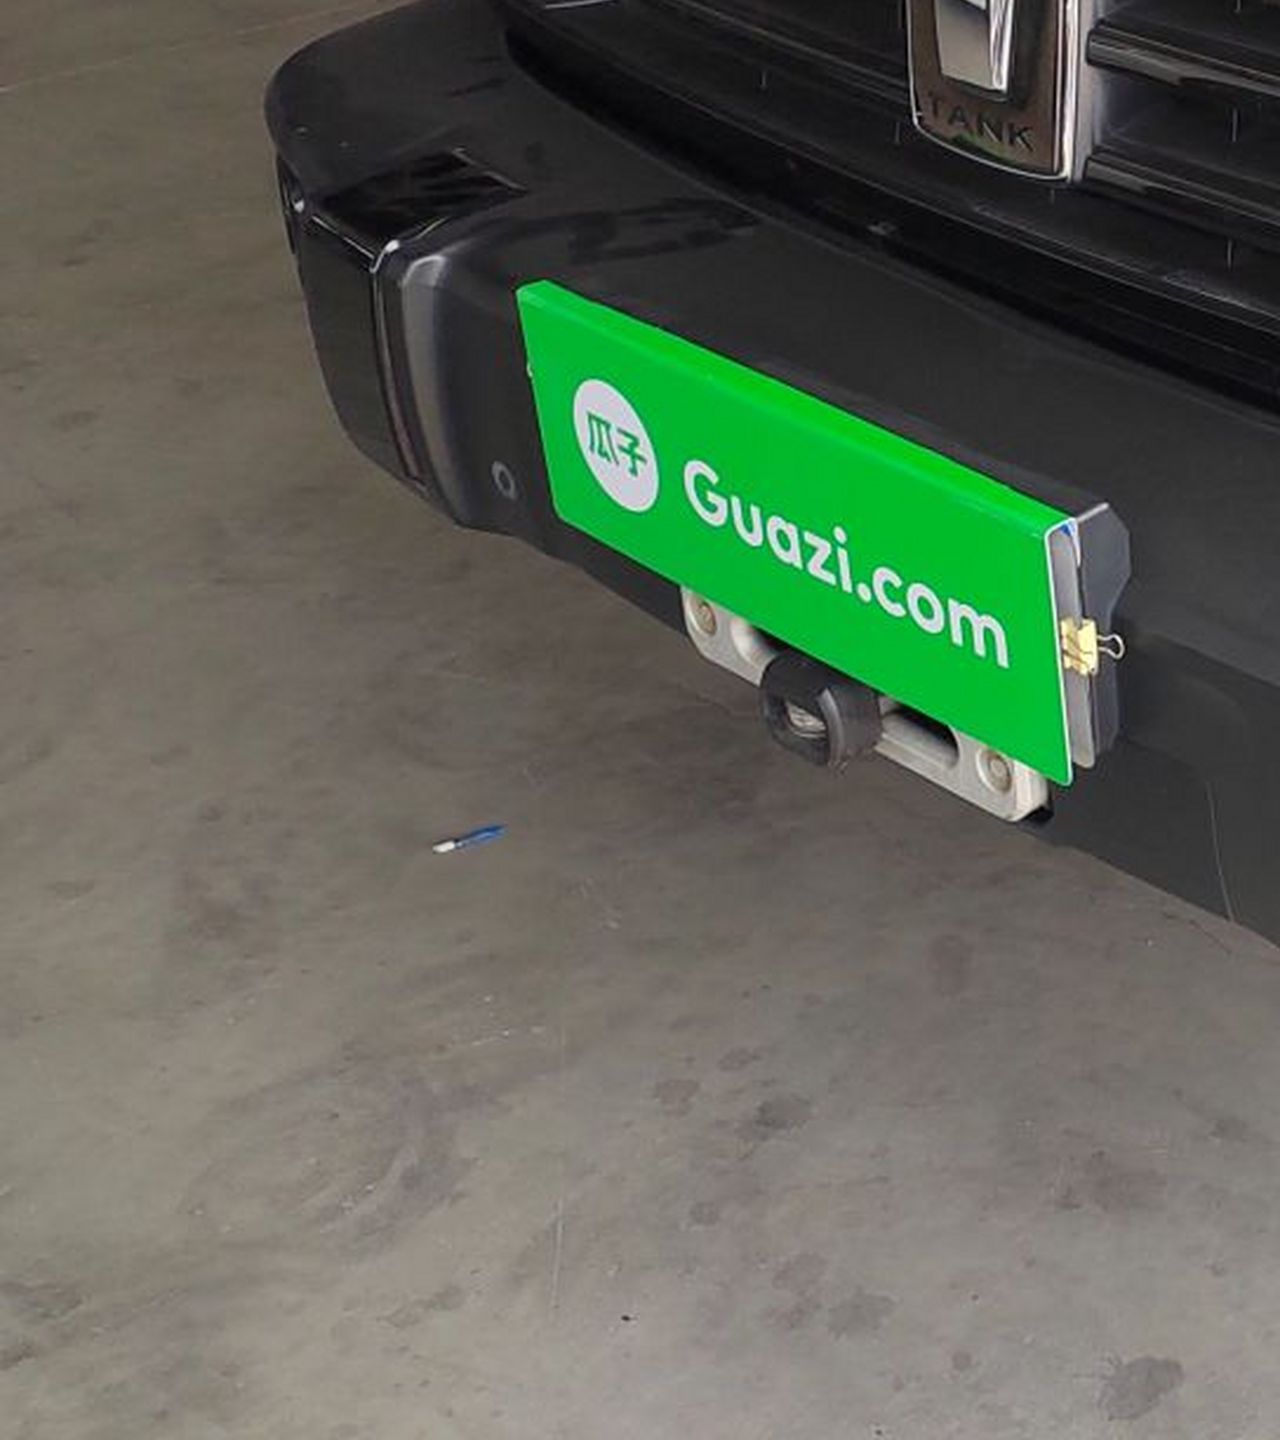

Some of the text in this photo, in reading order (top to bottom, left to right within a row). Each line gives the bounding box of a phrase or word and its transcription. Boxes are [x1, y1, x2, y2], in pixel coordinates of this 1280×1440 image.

[925, 89, 1034, 152] TANK
[586, 410, 648, 478] 瓜子
[683, 460, 1010, 668] Guazi.com
